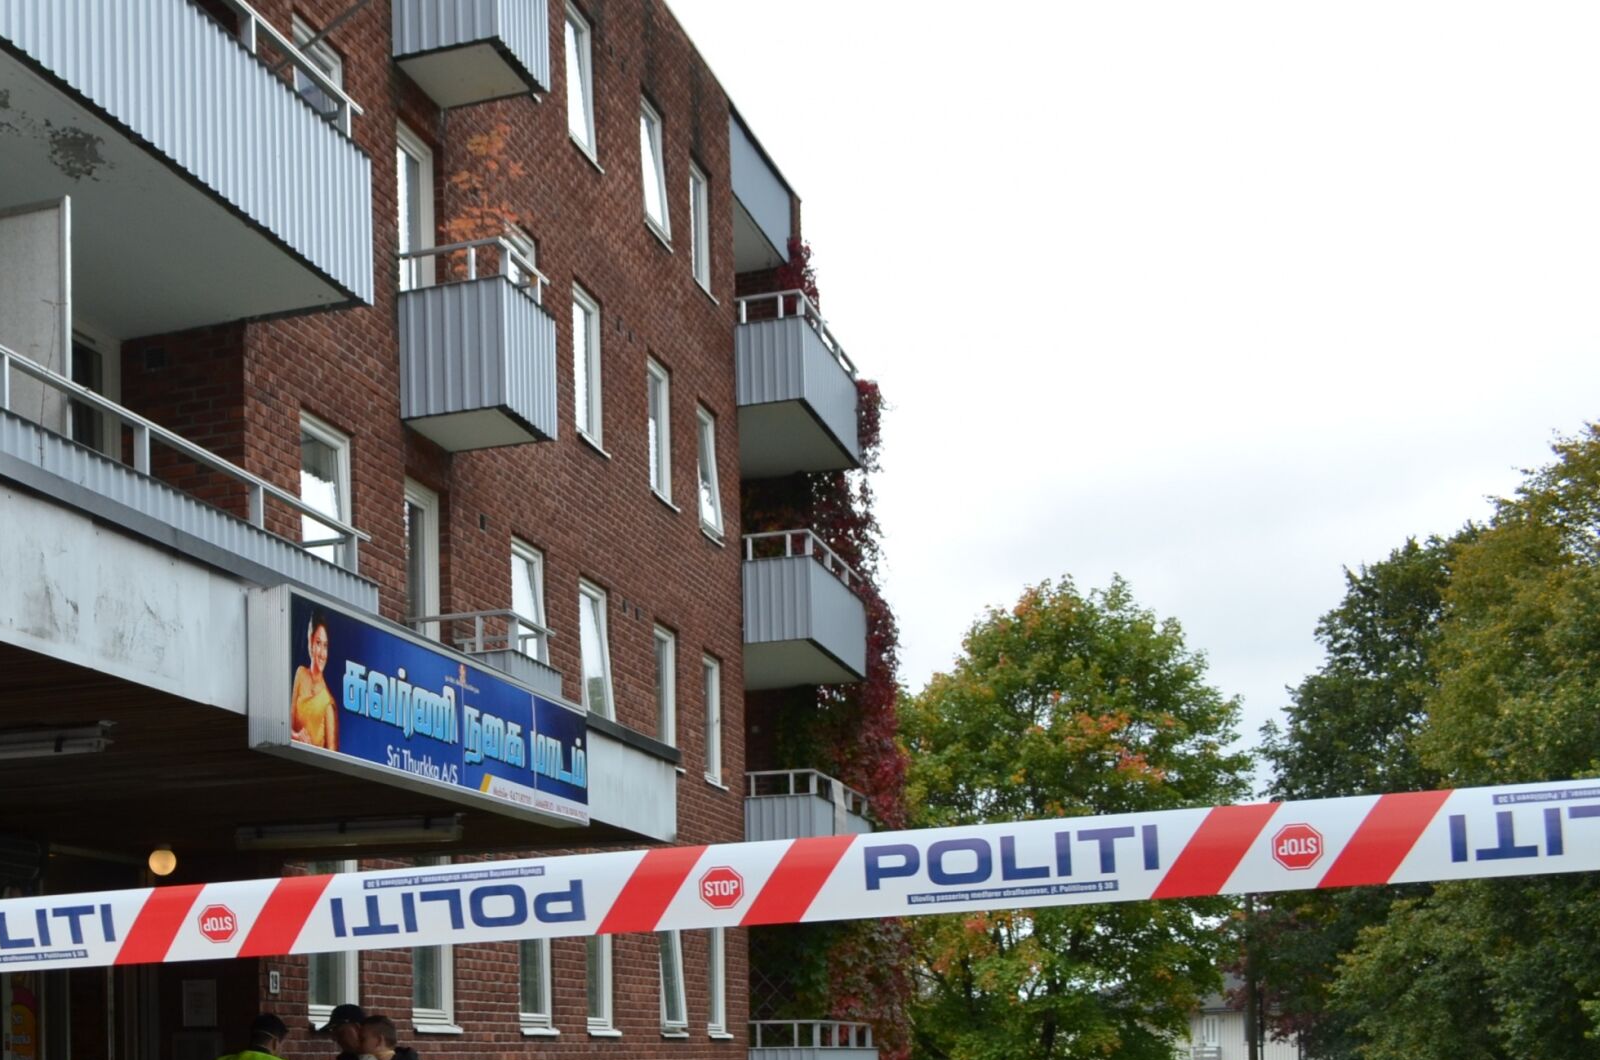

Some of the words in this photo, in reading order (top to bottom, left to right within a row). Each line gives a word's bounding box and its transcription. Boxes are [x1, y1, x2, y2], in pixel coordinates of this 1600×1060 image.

[387, 744, 401, 769] Sri
[441, 761, 458, 785] A/S
[463, 704, 526, 769] நகை
[529, 729, 588, 789] மாடம்
[863, 824, 1160, 891] POLITI
[1278, 837, 1318, 856] STOP
[330, 879, 587, 938] POLITI
[704, 880, 739, 898] STOP
[202, 916, 234, 932] STOP
